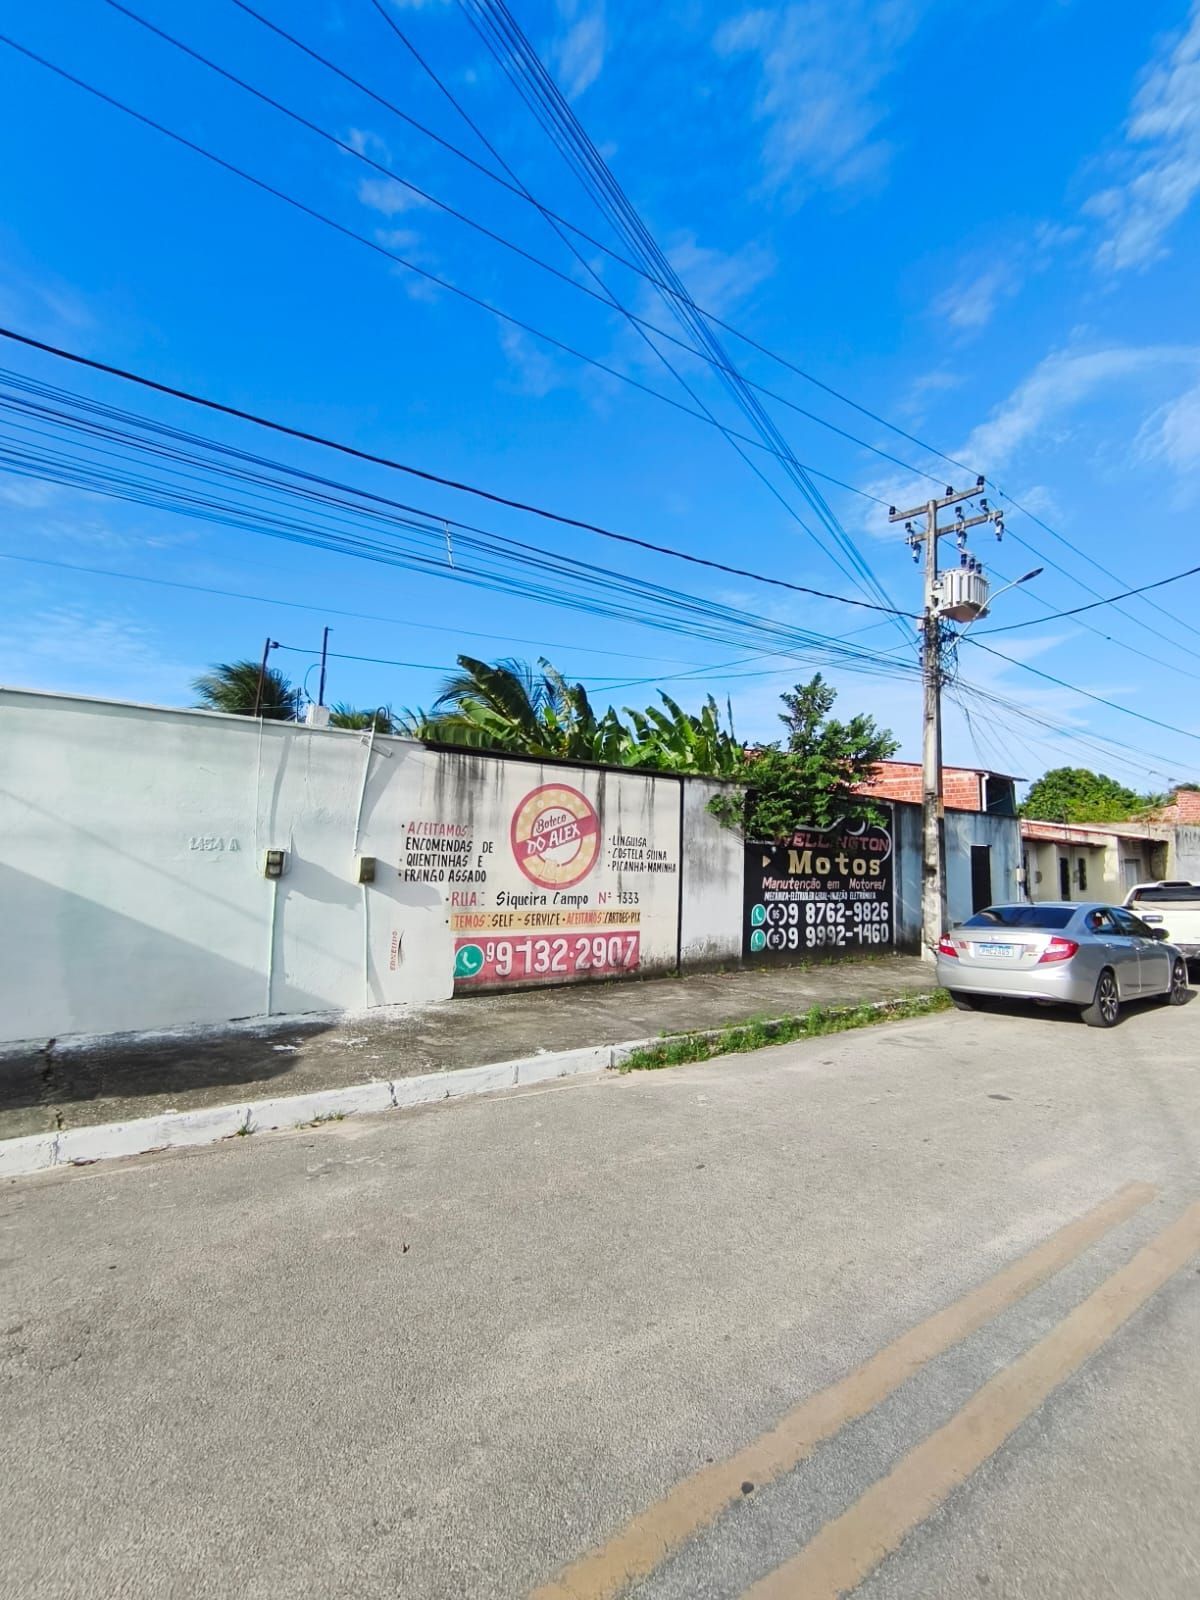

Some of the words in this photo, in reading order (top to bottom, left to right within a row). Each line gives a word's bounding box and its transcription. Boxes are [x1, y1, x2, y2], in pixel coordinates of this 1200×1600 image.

[536, 815, 567, 833] Boteco
[406, 837, 473, 853] ENCOMENDAS
[482, 841, 495, 854] DE
[527, 837, 546, 855] DO
[549, 823, 581, 847] ALEX
[406, 853, 469, 868] QUENTINHAS
[478, 855, 484, 868] E
[612, 848, 643, 860] COSTELA
[788, 850, 881, 876] Motos
[404, 868, 445, 883] FRANGO
[448, 869, 487, 883] ASSADO
[762, 876, 821, 891] Manutenção
[827, 880, 840, 890] em
[496, 890, 548, 910] Siqueira
[552, 891, 589, 910] Campo
[617, 891, 640, 905] 1333
[806, 901, 889, 925] 8762-9826
[806, 922, 889, 948] 9992-1460
